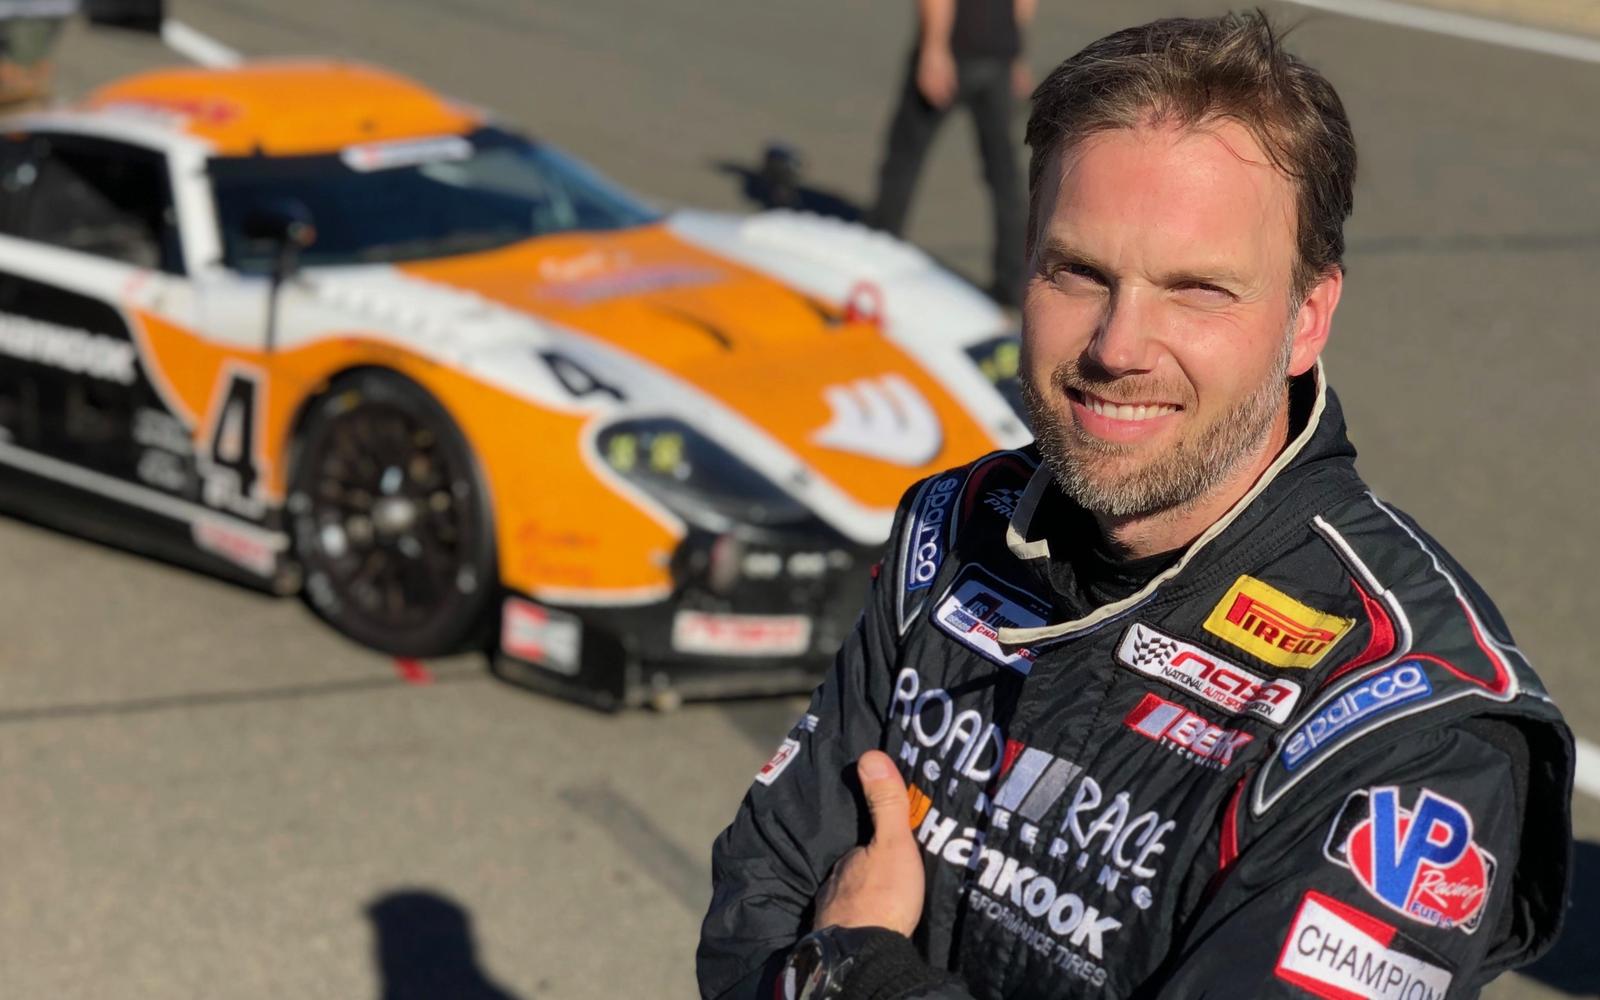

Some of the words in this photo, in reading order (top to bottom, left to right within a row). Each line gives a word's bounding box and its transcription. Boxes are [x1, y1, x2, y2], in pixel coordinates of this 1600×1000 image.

[538, 351, 627, 402] 4
[212, 375, 258, 498] 4
[1225, 591, 1337, 655] PIRELLI
[1160, 665, 1202, 692] NATIONAL
[1202, 686, 1226, 702] AUTO
[888, 667, 1004, 782] ROAD
[1059, 776, 1176, 878] RACE
[1370, 787, 1473, 910] VP
[1414, 869, 1484, 910] Racing
[1053, 944, 1108, 987] TIRES
